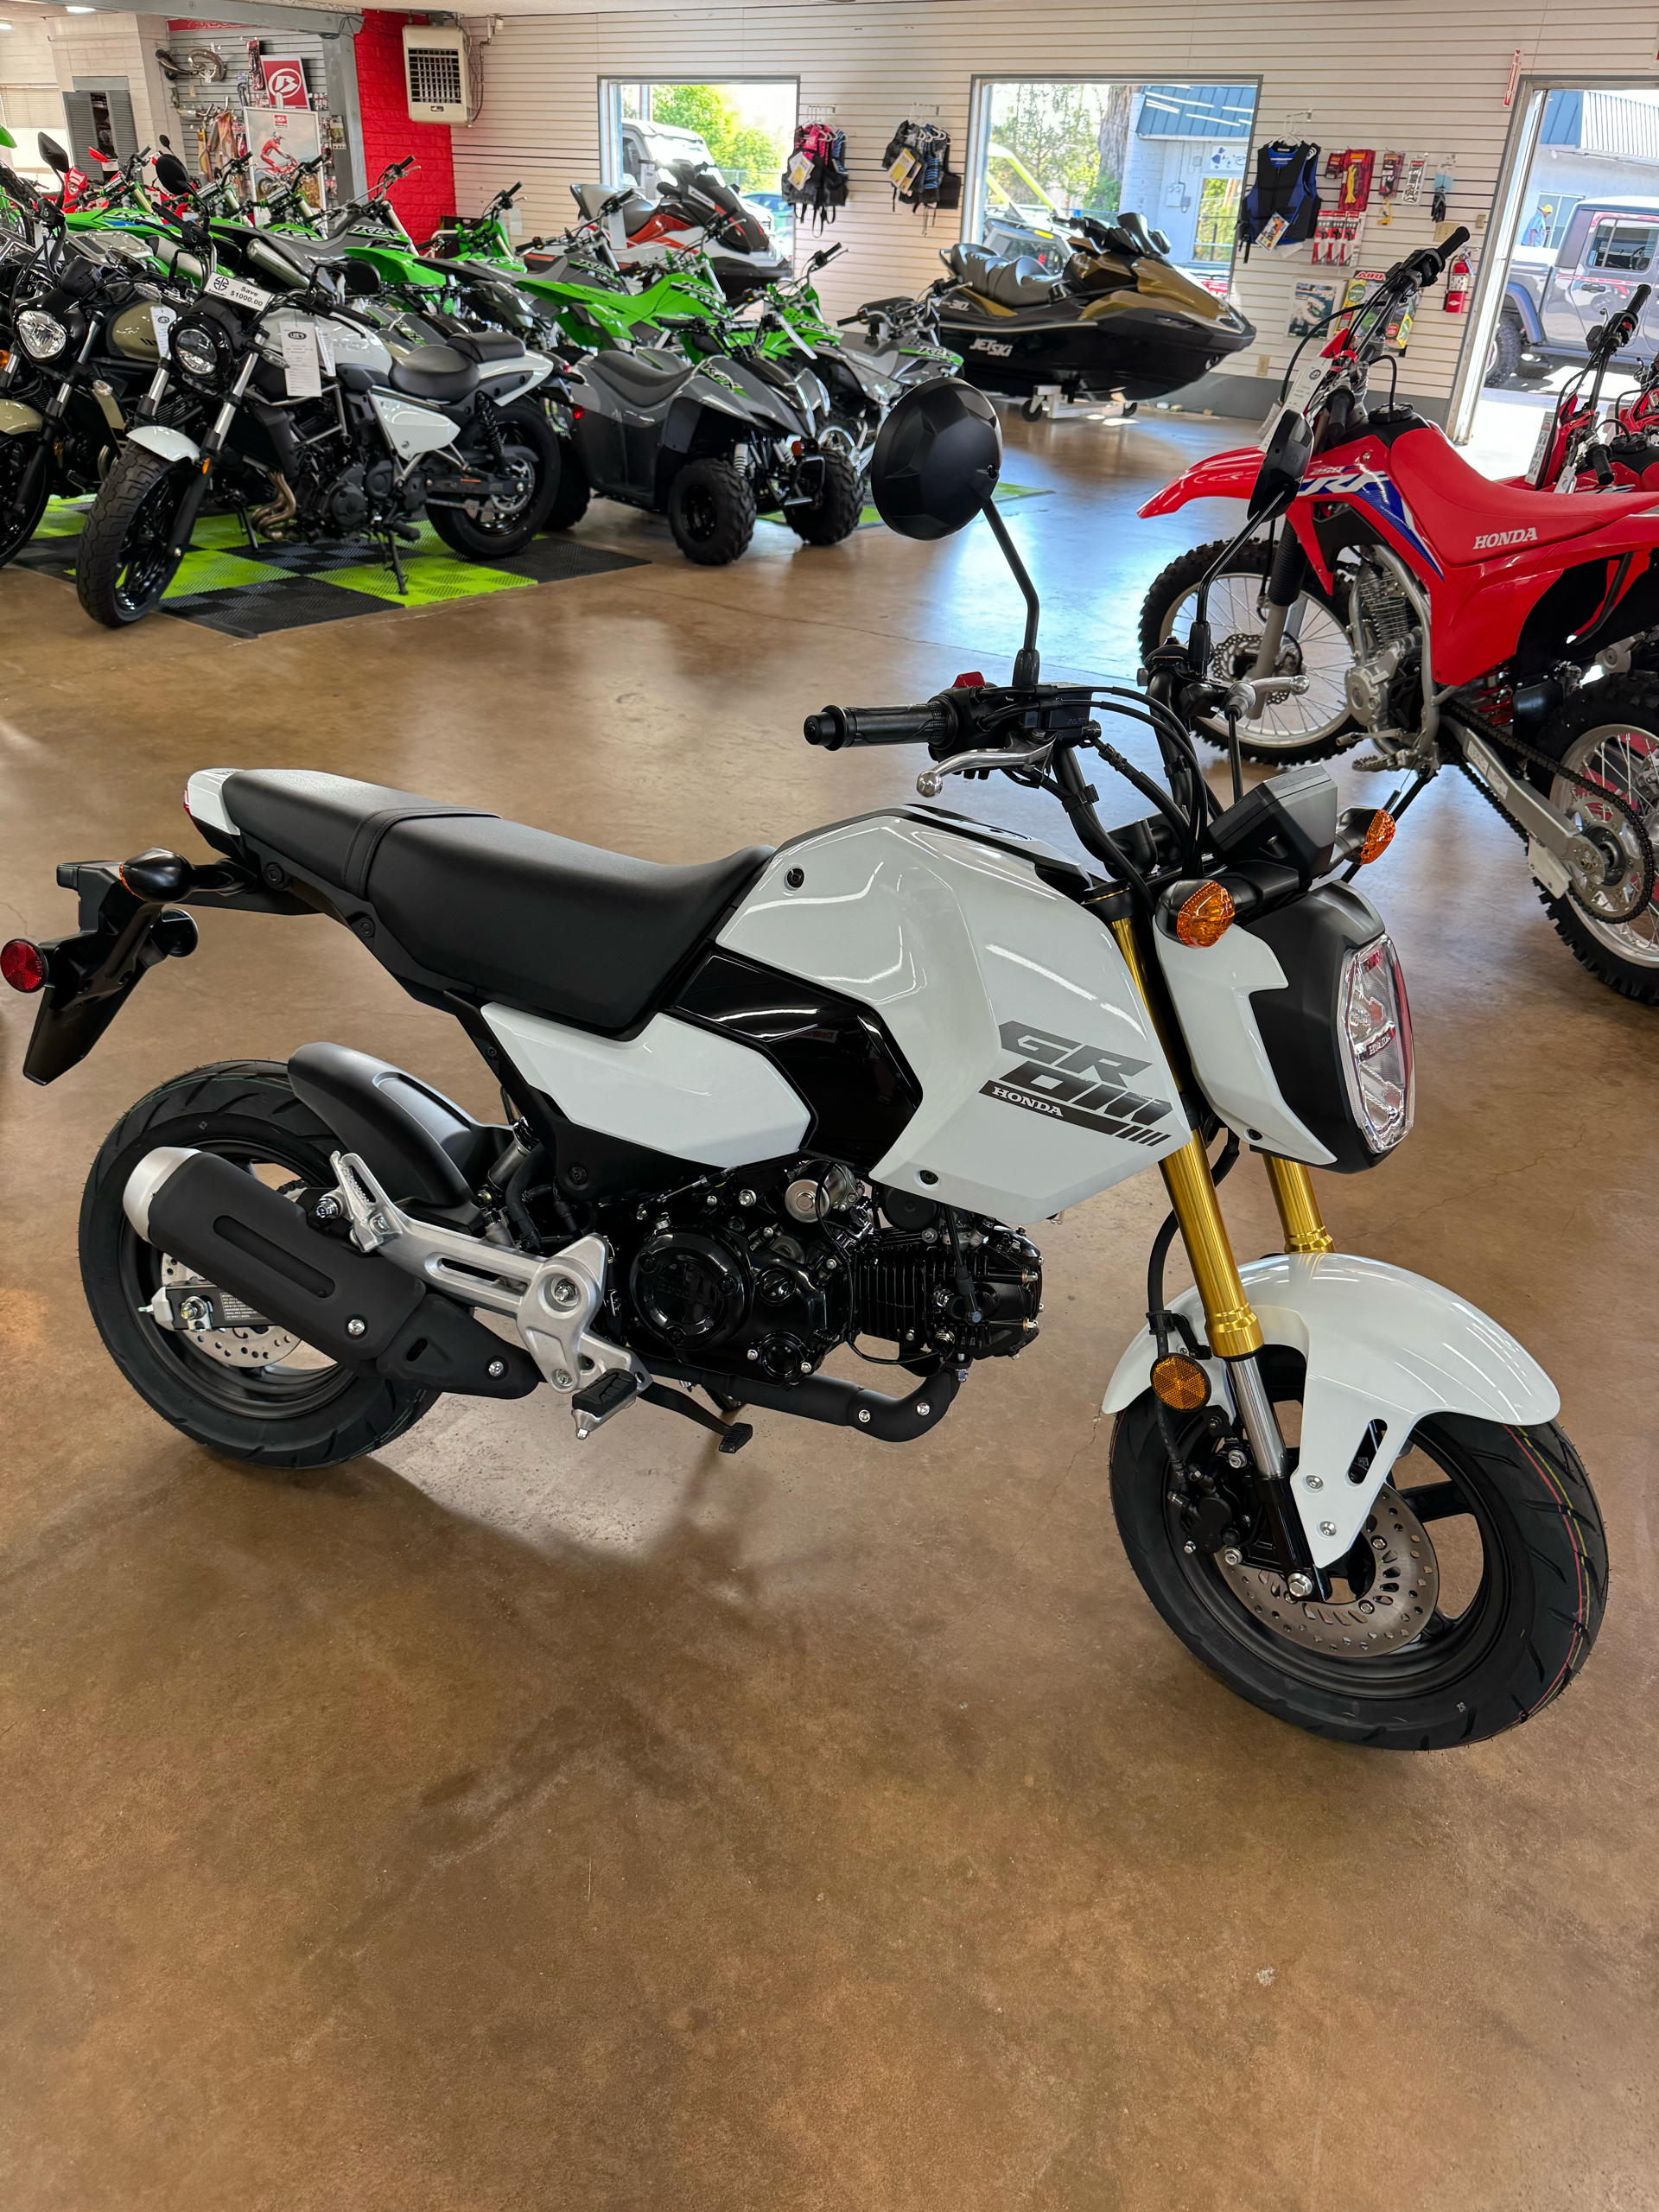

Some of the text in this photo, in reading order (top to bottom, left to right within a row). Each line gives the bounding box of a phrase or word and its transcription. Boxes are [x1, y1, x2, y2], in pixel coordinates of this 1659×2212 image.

[353, 225, 400, 238] KLX
[230, 290, 264, 307] $1000.00
[240, 286, 258, 296] Save
[969, 338, 997, 351] JET
[1472, 527, 1538, 550] HONDA
[998, 1020, 1153, 1088] GR
[992, 1086, 1064, 1117] HONDA
